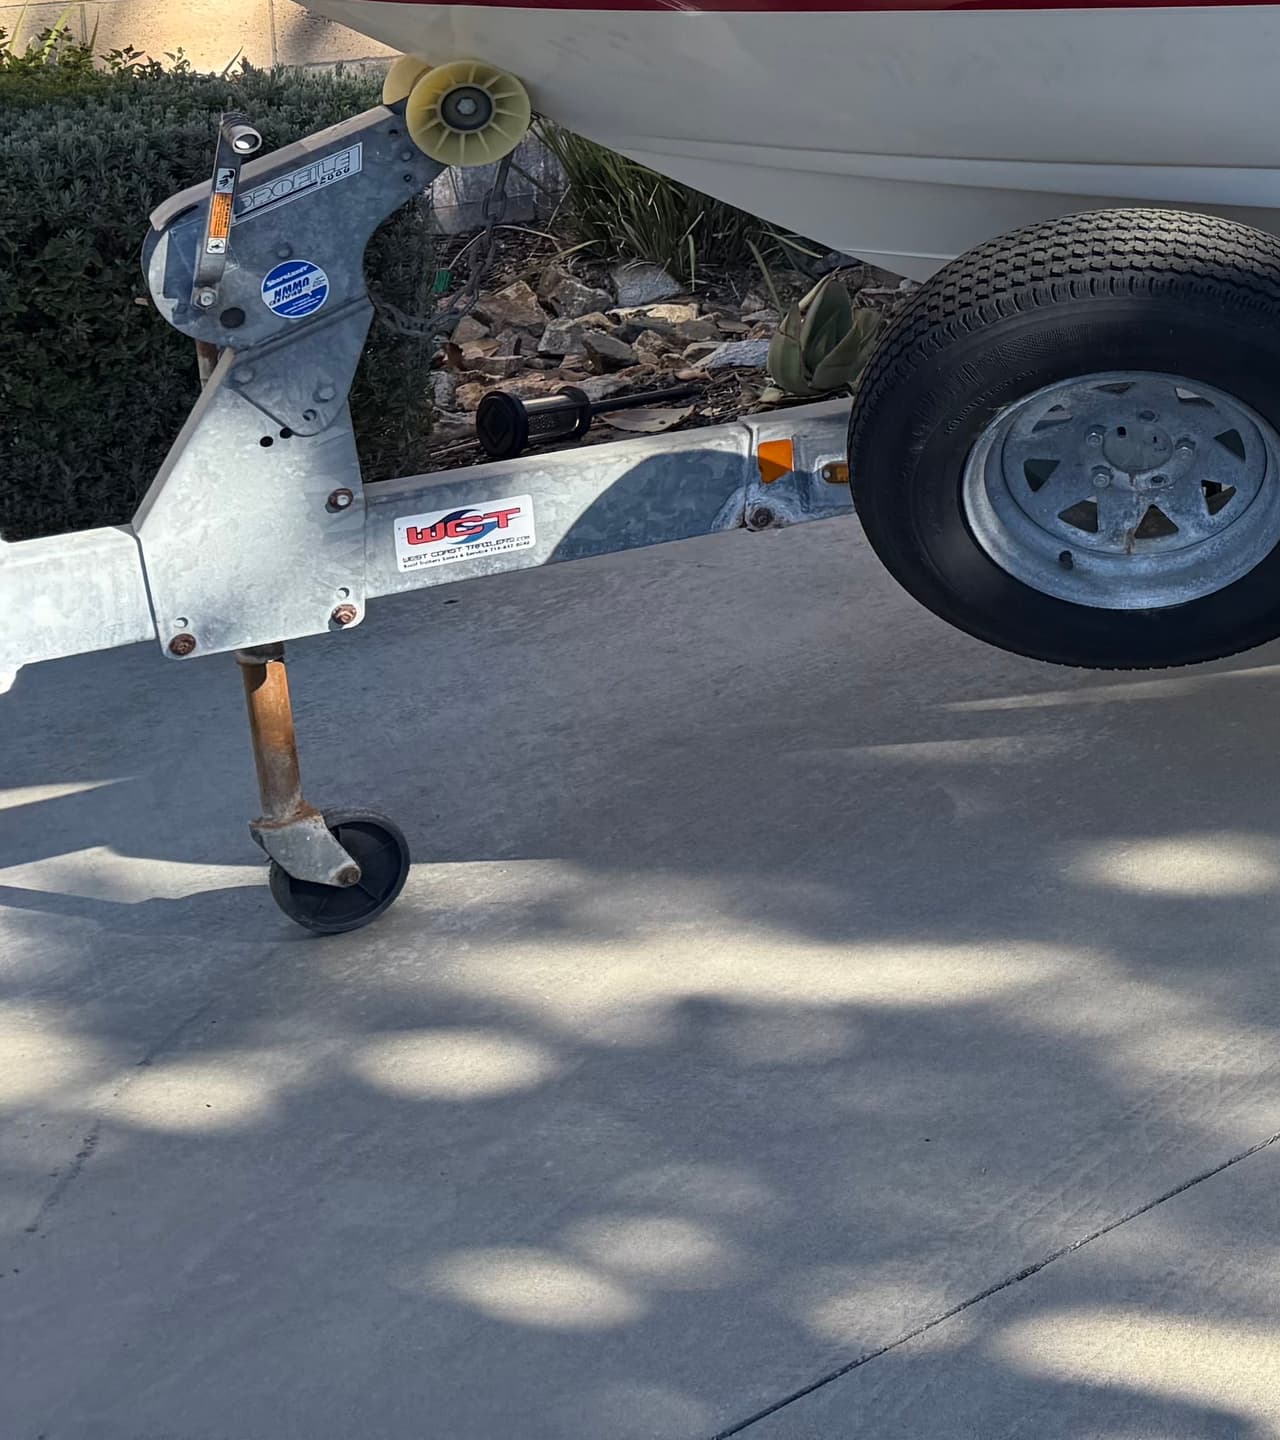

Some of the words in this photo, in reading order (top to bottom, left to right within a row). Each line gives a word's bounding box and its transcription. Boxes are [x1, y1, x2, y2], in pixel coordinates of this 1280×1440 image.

[406, 506, 521, 546] WCT
[402, 553, 428, 563] WEST
[430, 546, 462, 558] COAST
